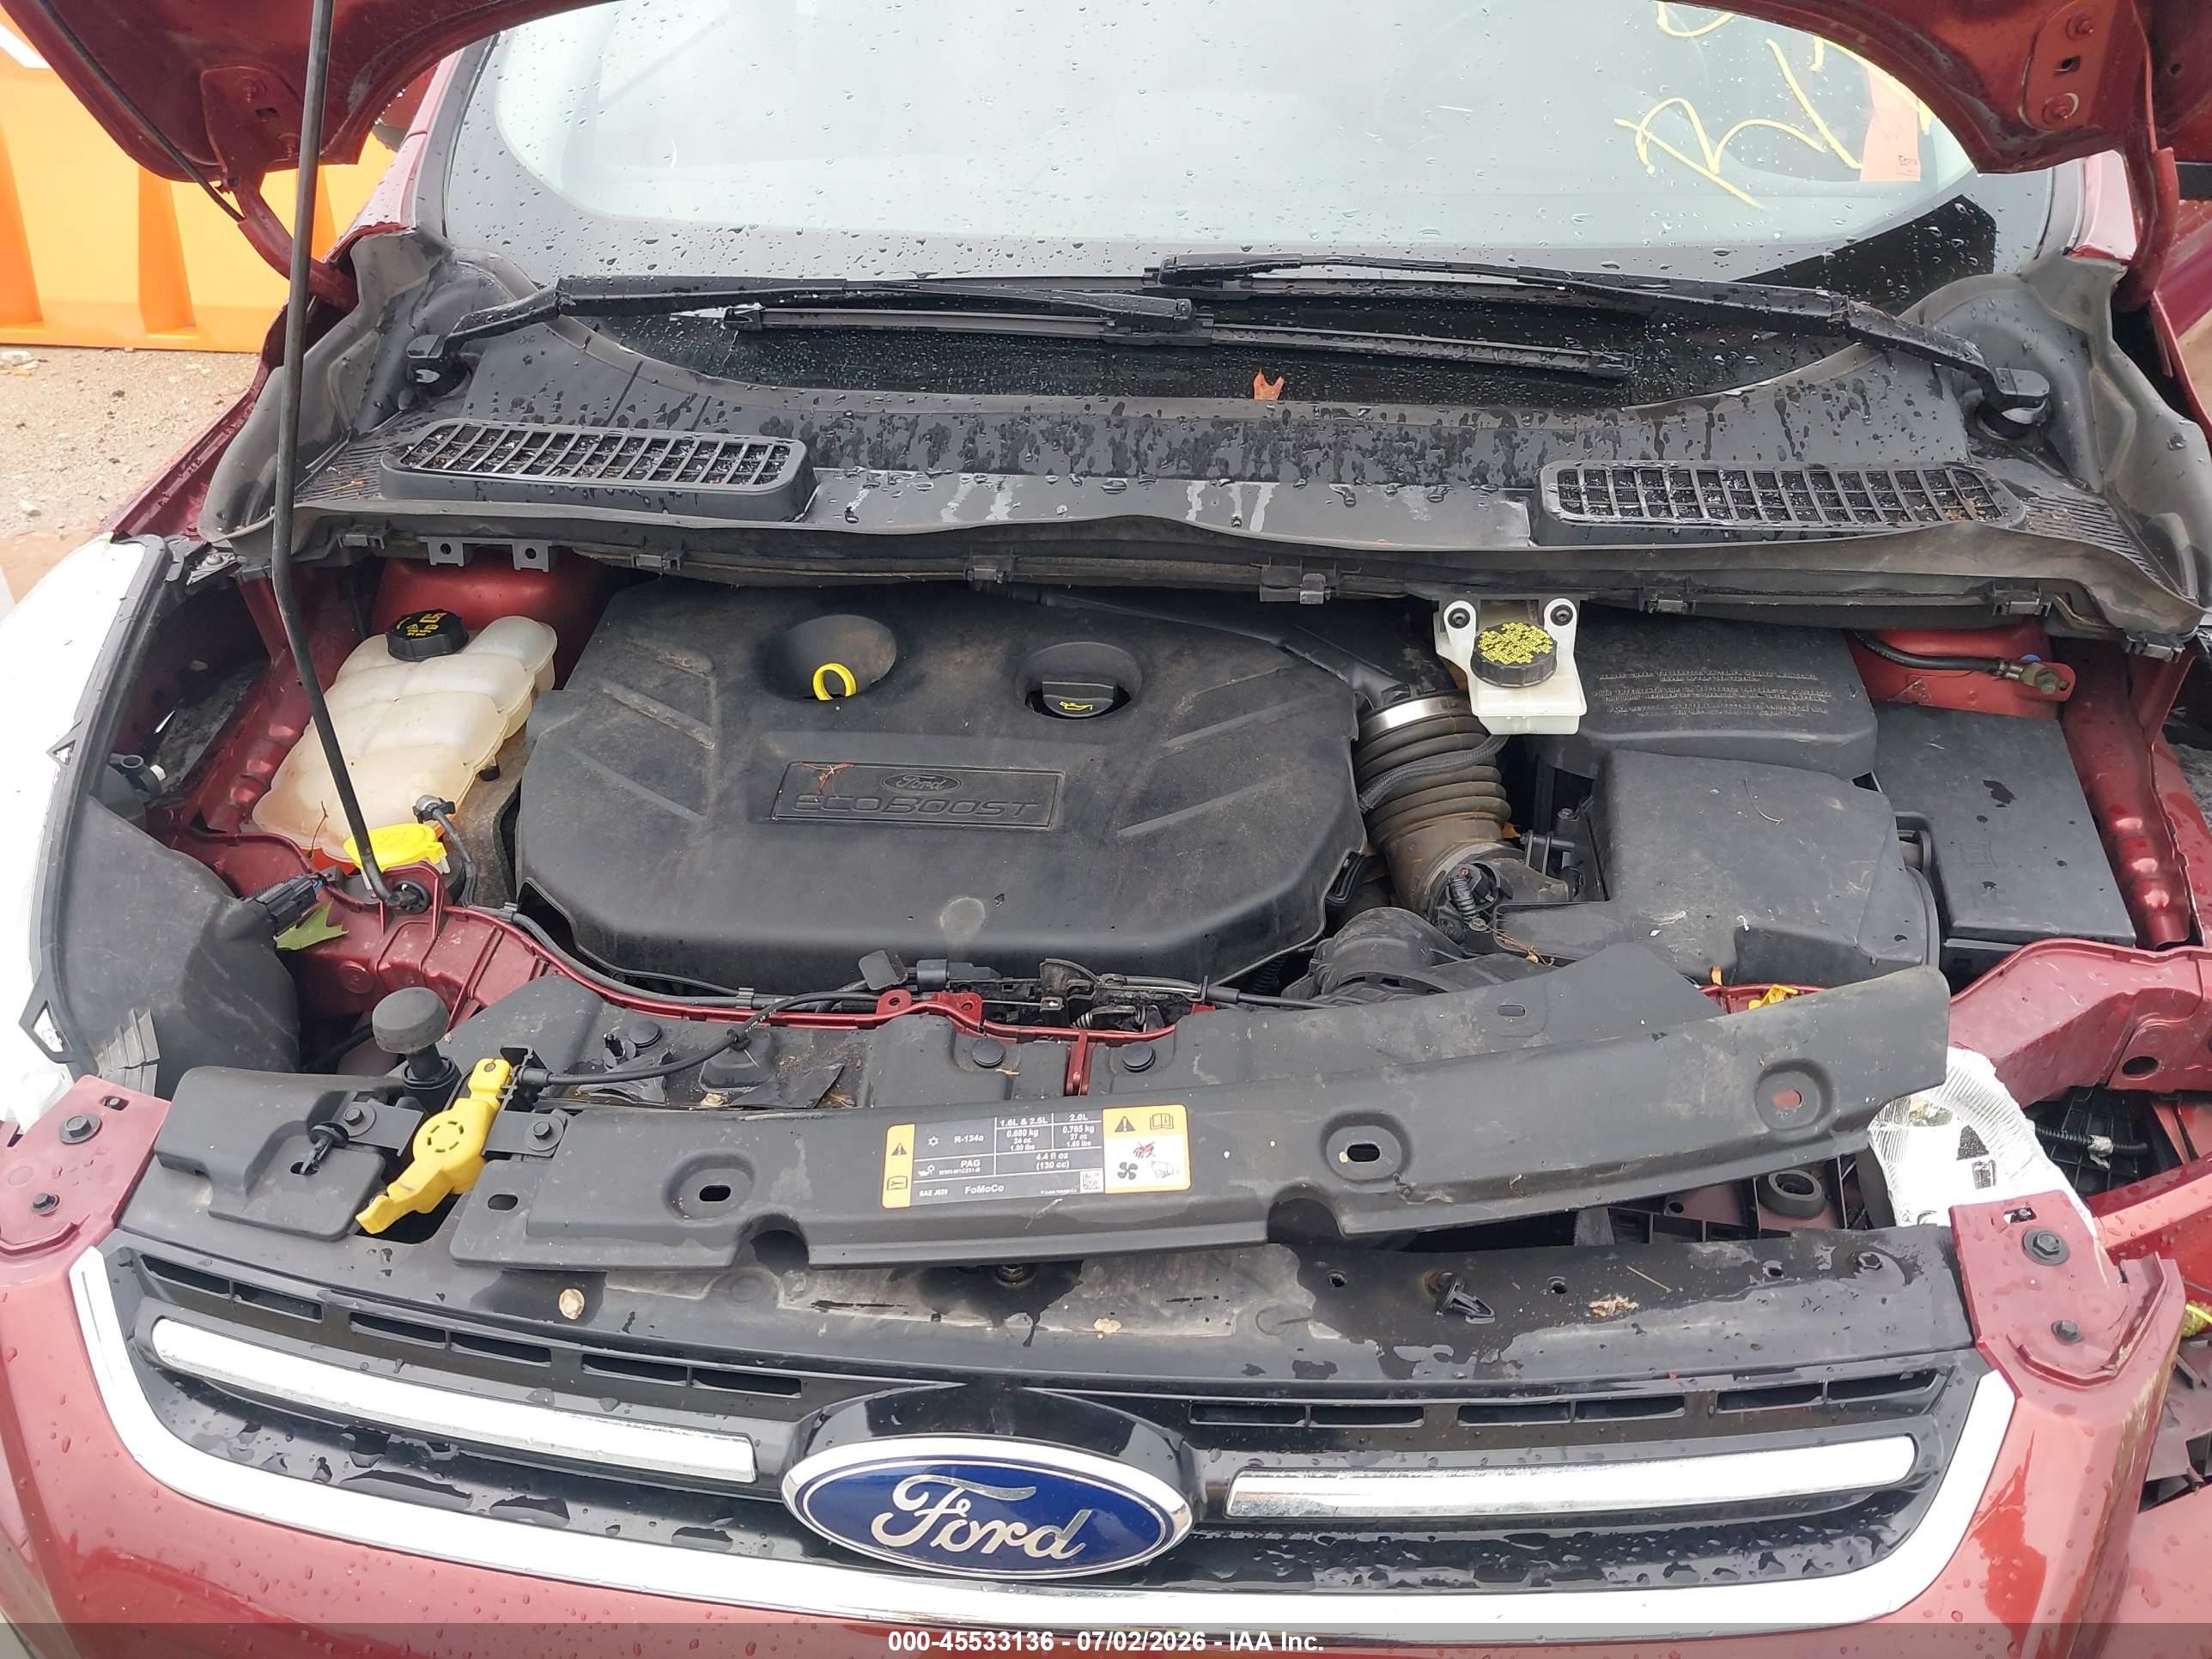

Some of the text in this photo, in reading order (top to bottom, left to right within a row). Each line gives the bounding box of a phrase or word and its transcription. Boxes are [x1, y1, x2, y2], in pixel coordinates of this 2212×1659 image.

[895, 775, 948, 792] Ford
[1069, 1113, 1089, 1121] 2.0L
[1029, 1128, 1039, 1137] kg
[1085, 1125, 1095, 1133] kg
[954, 1134, 984, 1144] R-134a
[961, 1159, 981, 1168] PAG
[1036, 1160, 1070, 1170] (130 cc)
[964, 1183, 1005, 1195] FoMoCo
[870, 1474, 1093, 1560] Ford
